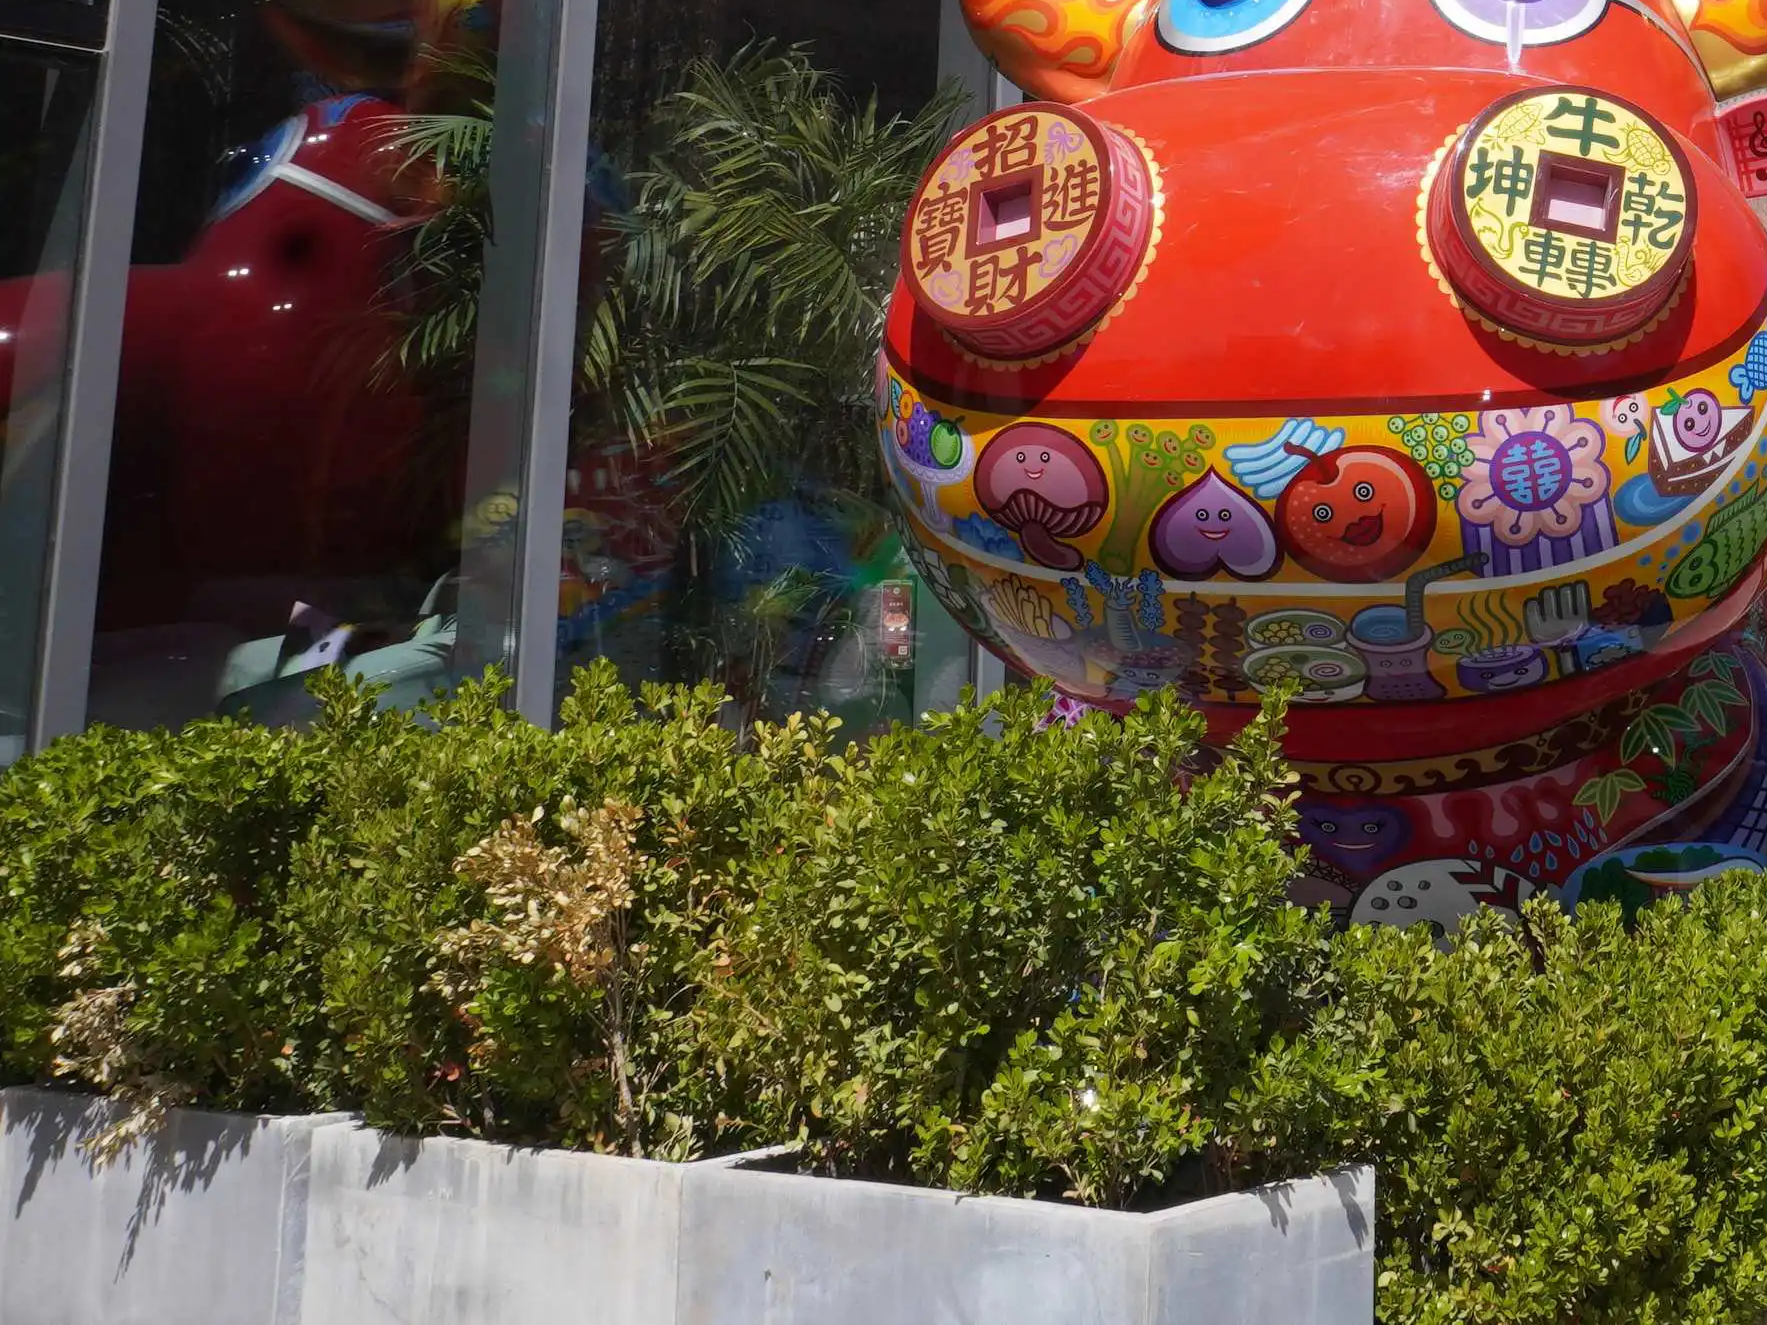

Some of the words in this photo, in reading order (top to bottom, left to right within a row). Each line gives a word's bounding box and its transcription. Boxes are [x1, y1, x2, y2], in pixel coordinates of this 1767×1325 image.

[972, 115, 1038, 178] 招
[1544, 96, 1620, 156] 牛
[1043, 159, 1098, 231] 進
[1466, 145, 1534, 217] 坤
[1621, 172, 1684, 250] 乾
[915, 182, 969, 280] 寶
[1518, 231, 1617, 299] 轉
[964, 246, 1044, 316] 財
